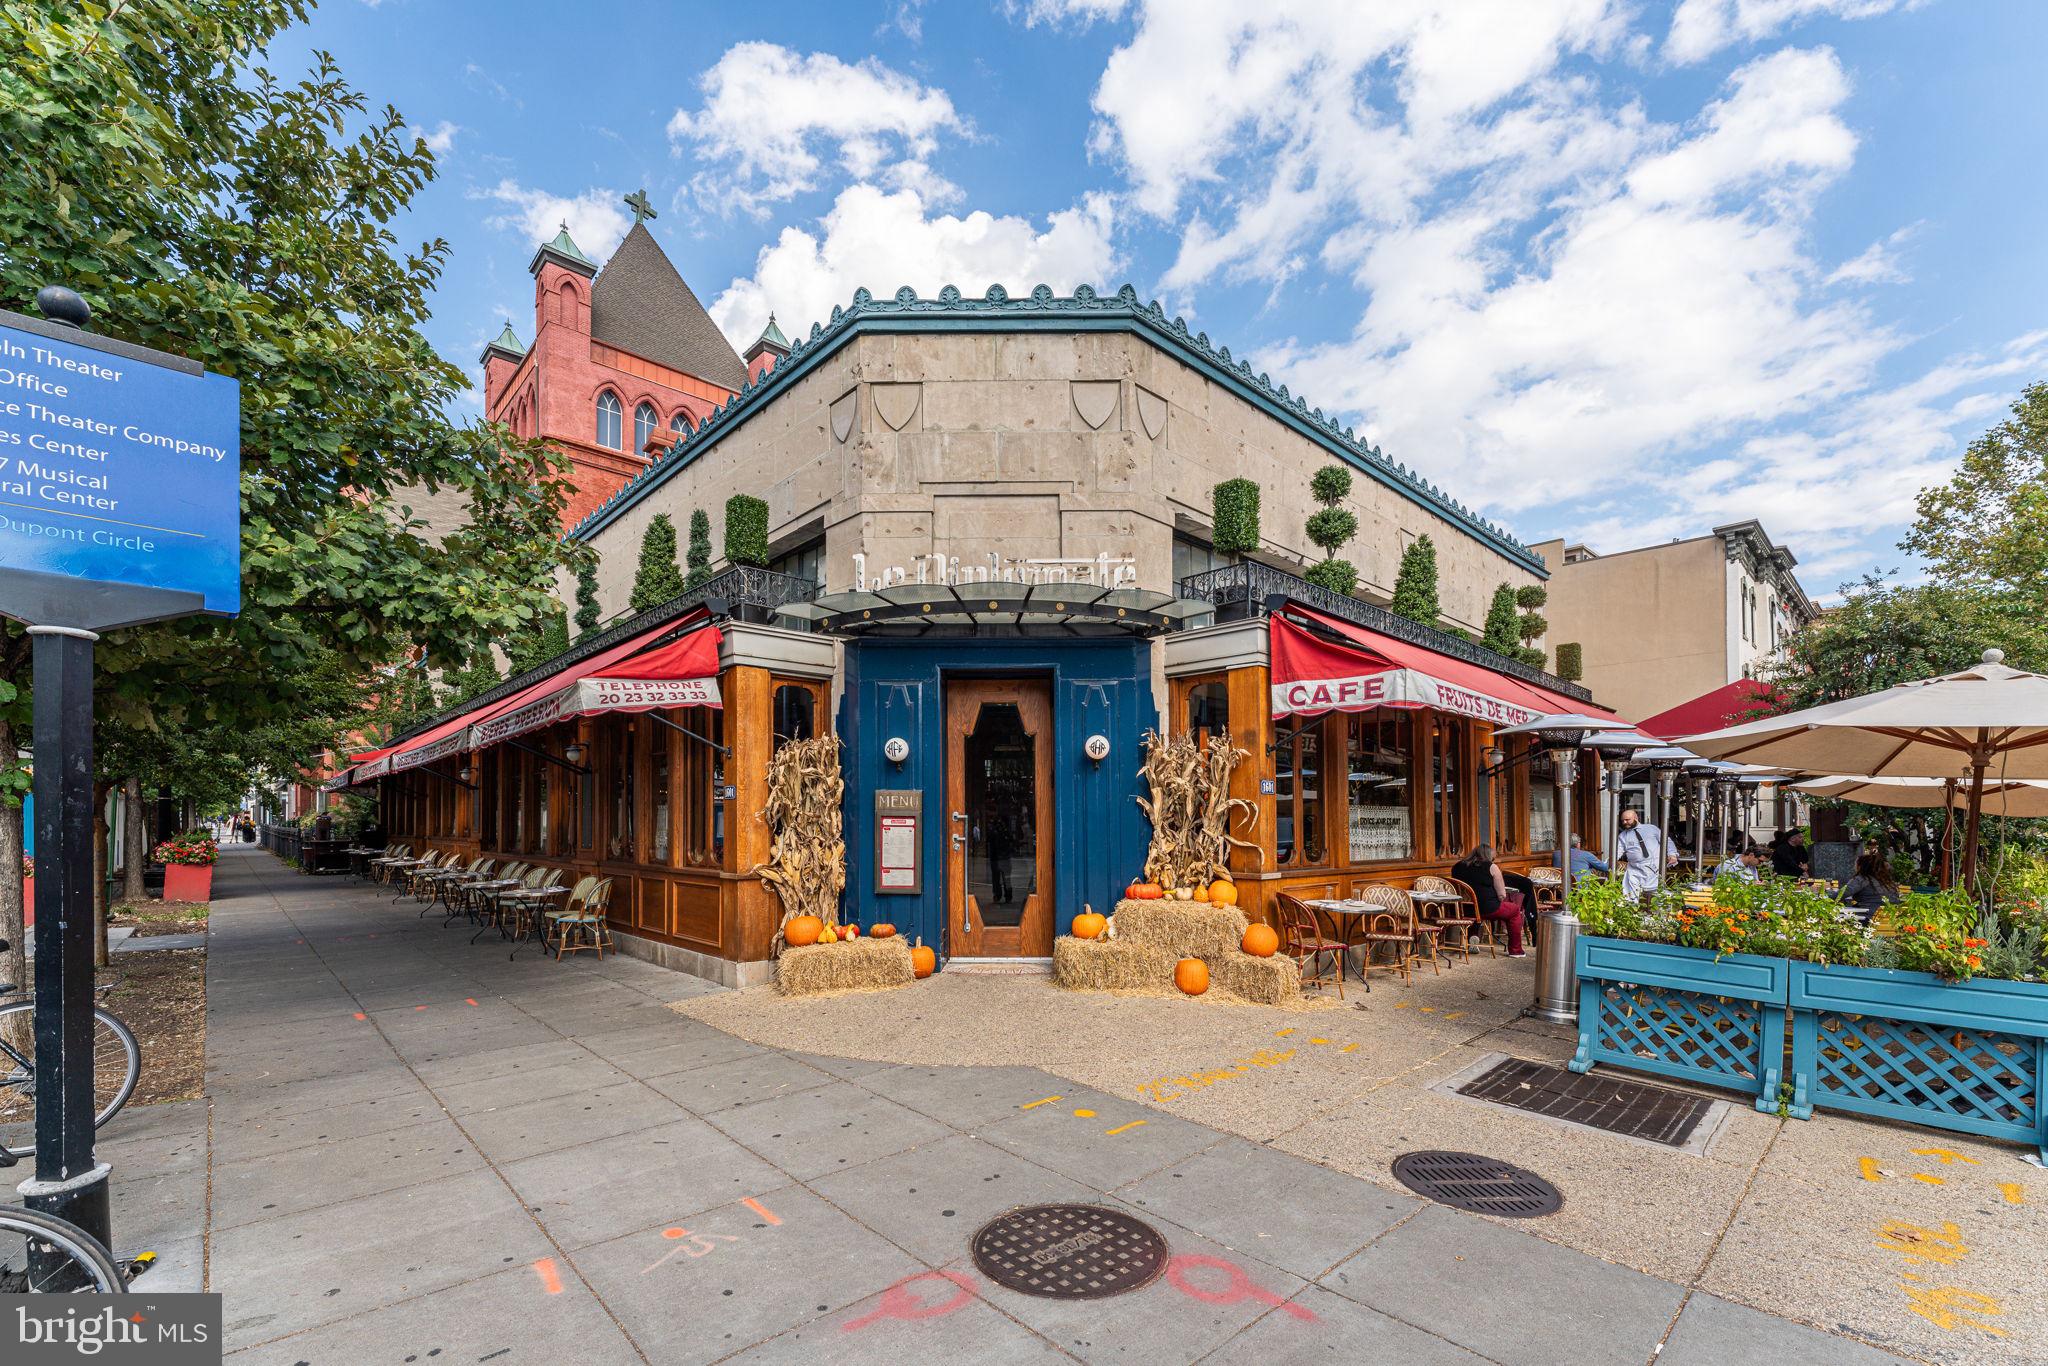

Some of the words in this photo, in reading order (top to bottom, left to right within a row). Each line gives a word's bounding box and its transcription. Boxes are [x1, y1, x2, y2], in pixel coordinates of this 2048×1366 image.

[32, 346, 123, 383] Theater
[0, 369, 68, 398] Office
[27, 403, 117, 436] Theater
[123, 426, 226, 462] Company
[29, 435, 109, 462] Center
[18, 460, 108, 490] Musical
[40, 486, 118, 511] Center
[92, 529, 155, 553] Circle
[597, 681, 703, 691] TELEPHONE
[600, 694, 620, 705] 20
[625, 693, 643, 703] 23
[647, 692, 664, 702] 32
[669, 691, 687, 701] 33
[691, 691, 708, 700] 33
[1288, 677, 1385, 707] CAFE
[1435, 684, 1482, 714] FRUITS
[1488, 700, 1502, 721] DE
[1506, 707, 1529, 725] MER
[879, 795, 919, 808] MENU
